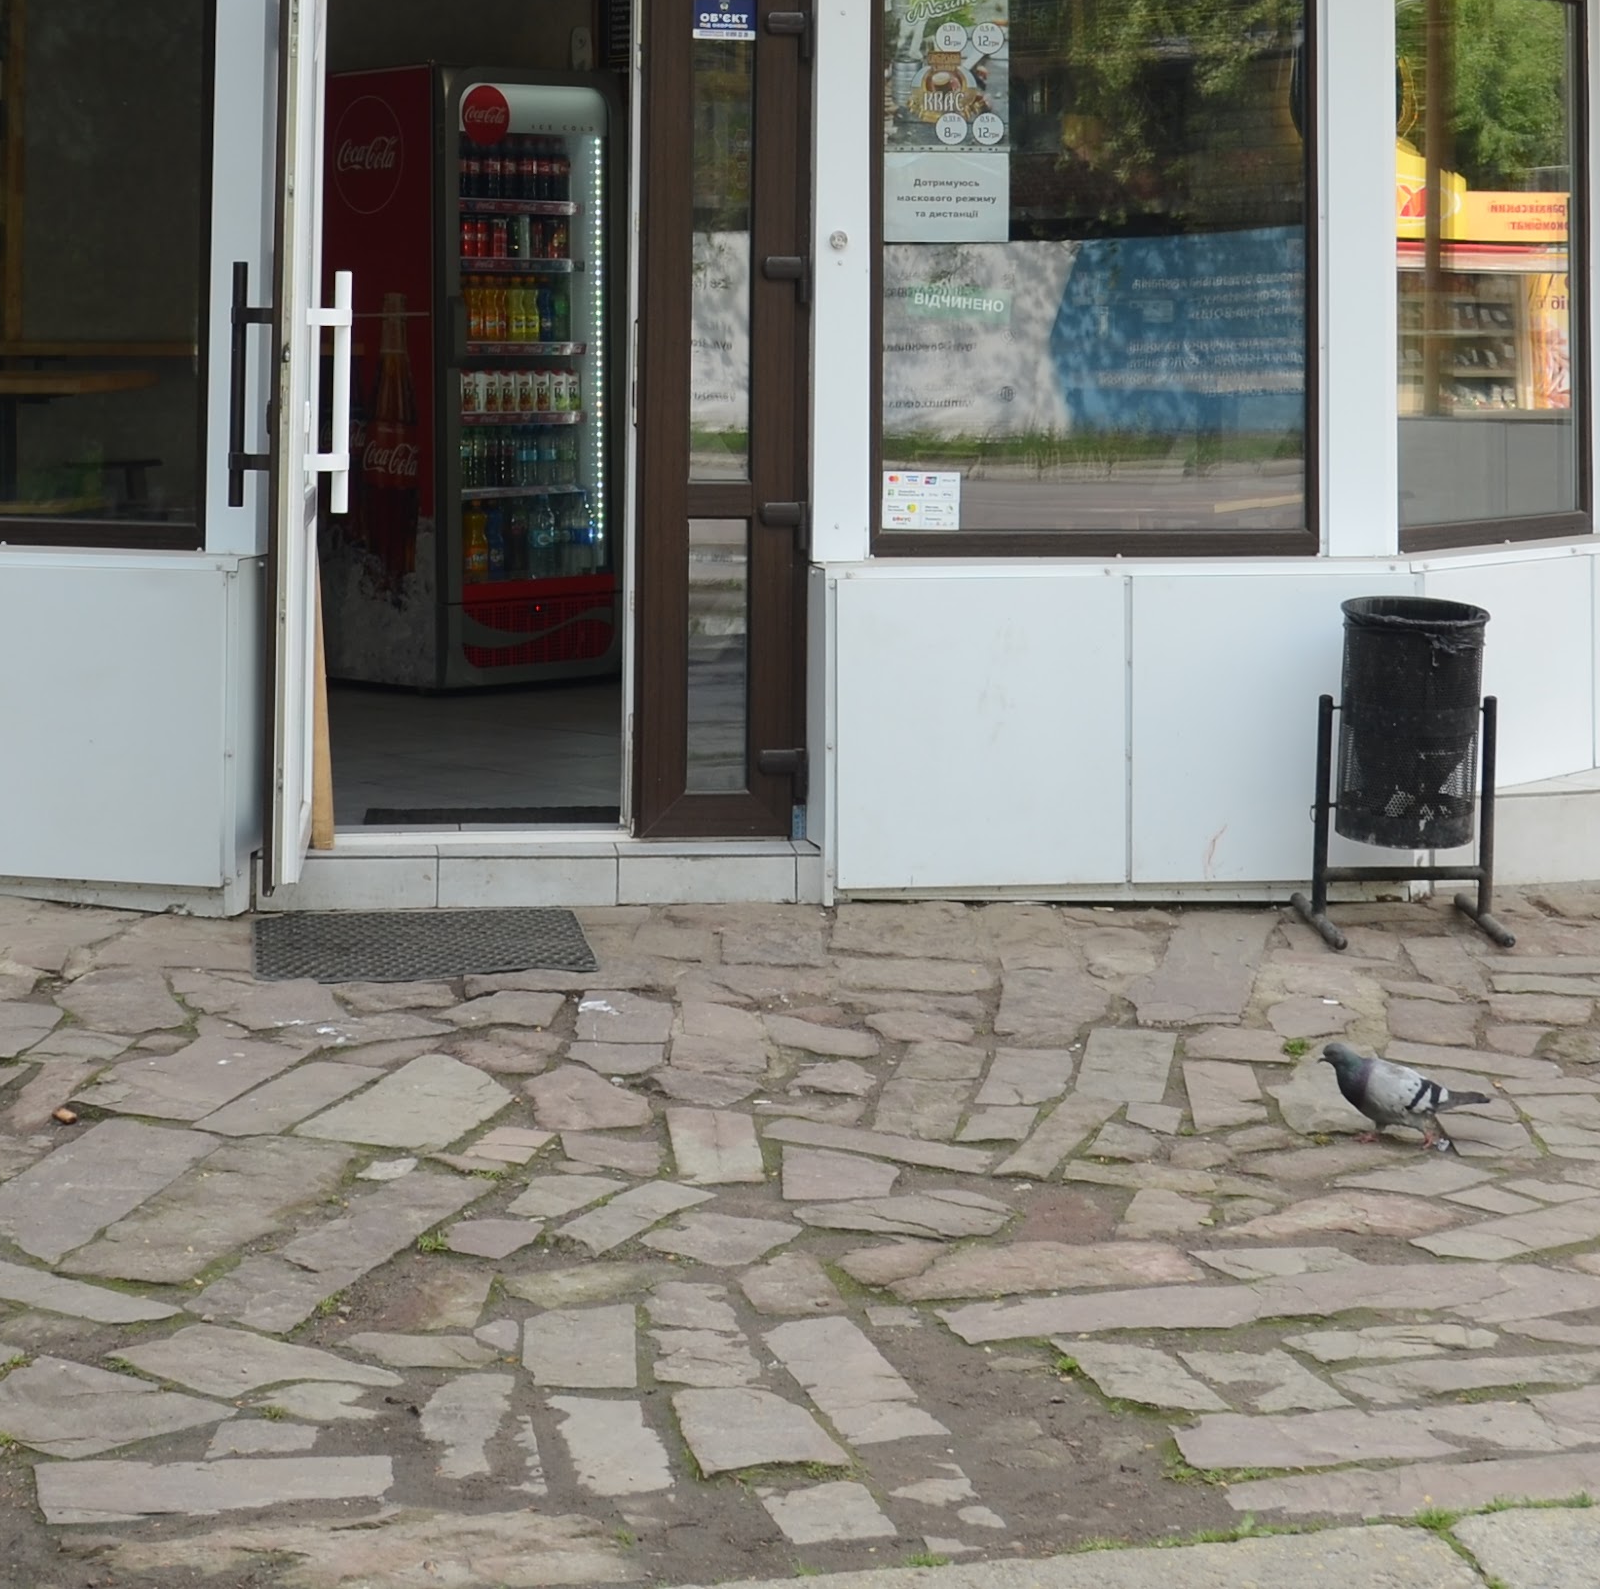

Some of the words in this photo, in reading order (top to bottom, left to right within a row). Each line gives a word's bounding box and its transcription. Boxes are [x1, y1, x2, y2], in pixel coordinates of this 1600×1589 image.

[923, 92, 965, 110] КВАС
[337, 136, 399, 172] Coca-Cola
[913, 178, 980, 188] Дотримуюсь
[897, 195, 953, 203] маскового
[955, 195, 997, 204] режиму
[928, 210, 979, 219] дистанції
[914, 292, 1005, 313] ВІДЧИНЕНО
[363, 440, 418, 476] Coca-Cola
